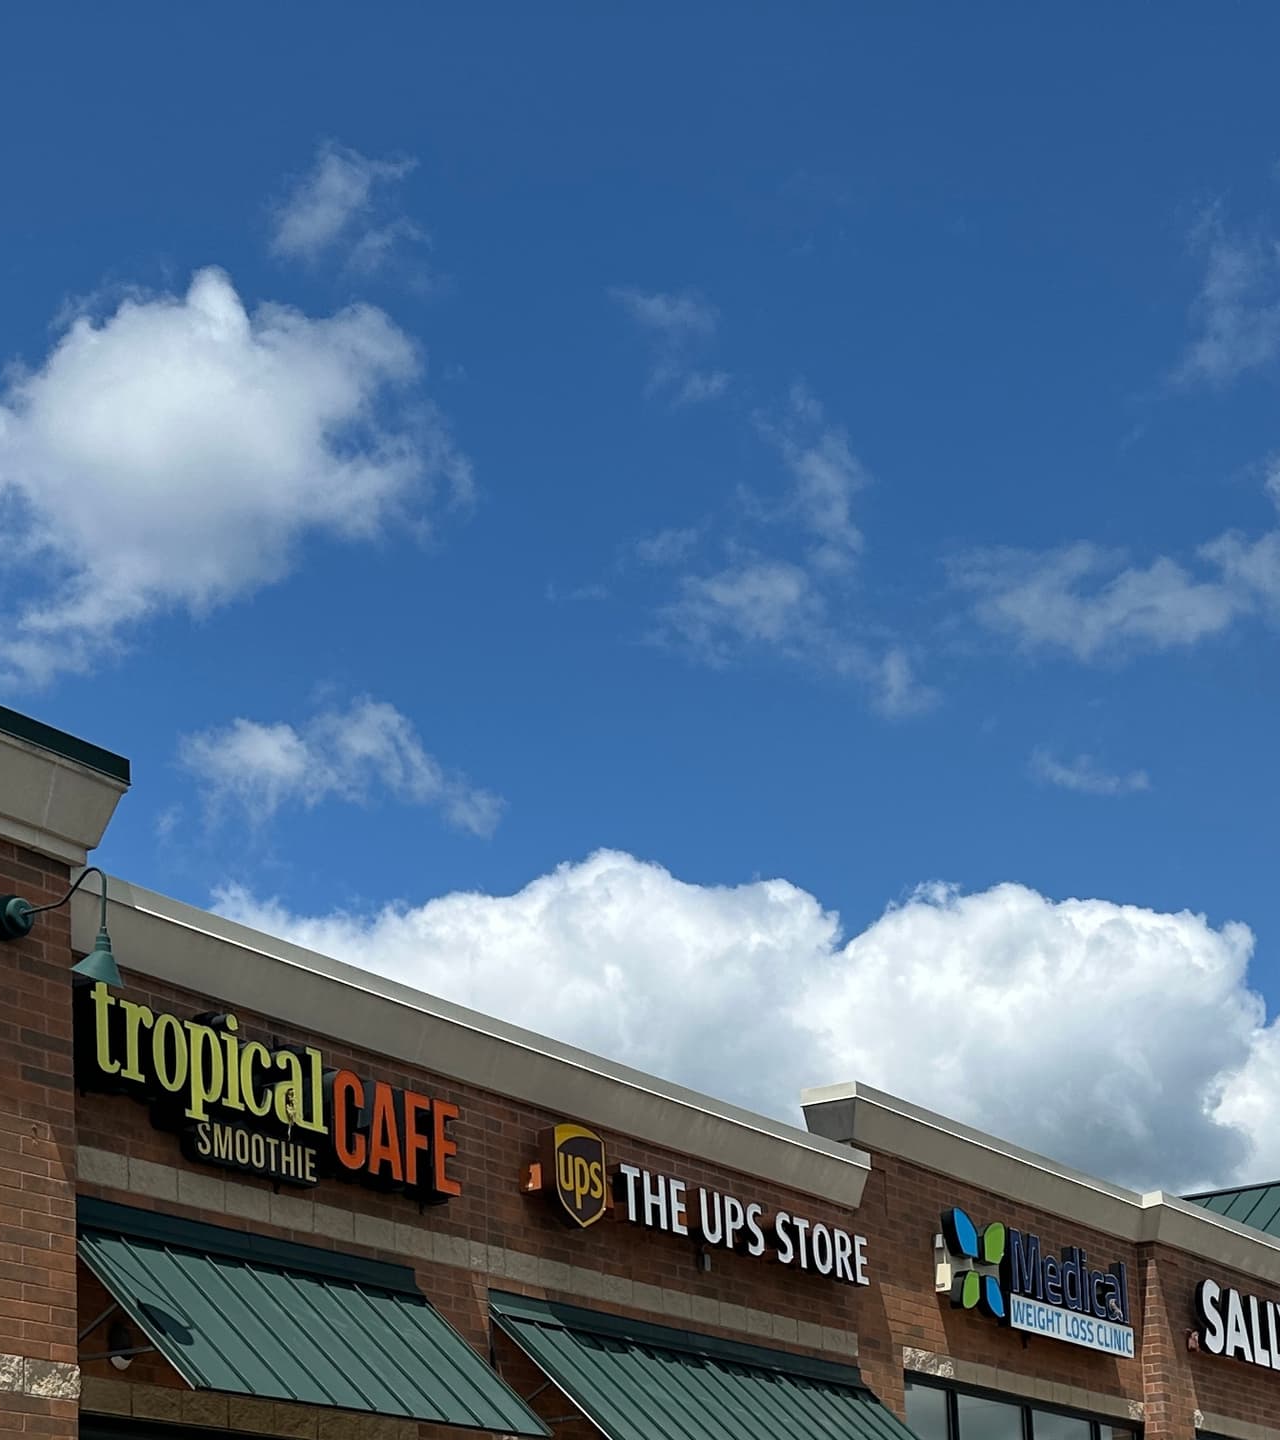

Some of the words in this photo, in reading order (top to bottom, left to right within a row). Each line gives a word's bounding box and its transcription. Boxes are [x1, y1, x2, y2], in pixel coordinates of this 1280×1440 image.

[91, 982, 328, 1135] tropical
[332, 1069, 461, 1197] CAFE
[197, 1122, 317, 1183] SMOOTHIE
[559, 1152, 603, 1209] ups
[620, 1163, 688, 1236] THE
[700, 1188, 765, 1256] UPS
[775, 1211, 870, 1286] STORE
[1009, 1227, 1129, 1324] Medical
[1012, 1299, 1062, 1335] WEIGHT
[1066, 1312, 1094, 1343] LOSS
[1096, 1323, 1133, 1355] CLINIC
